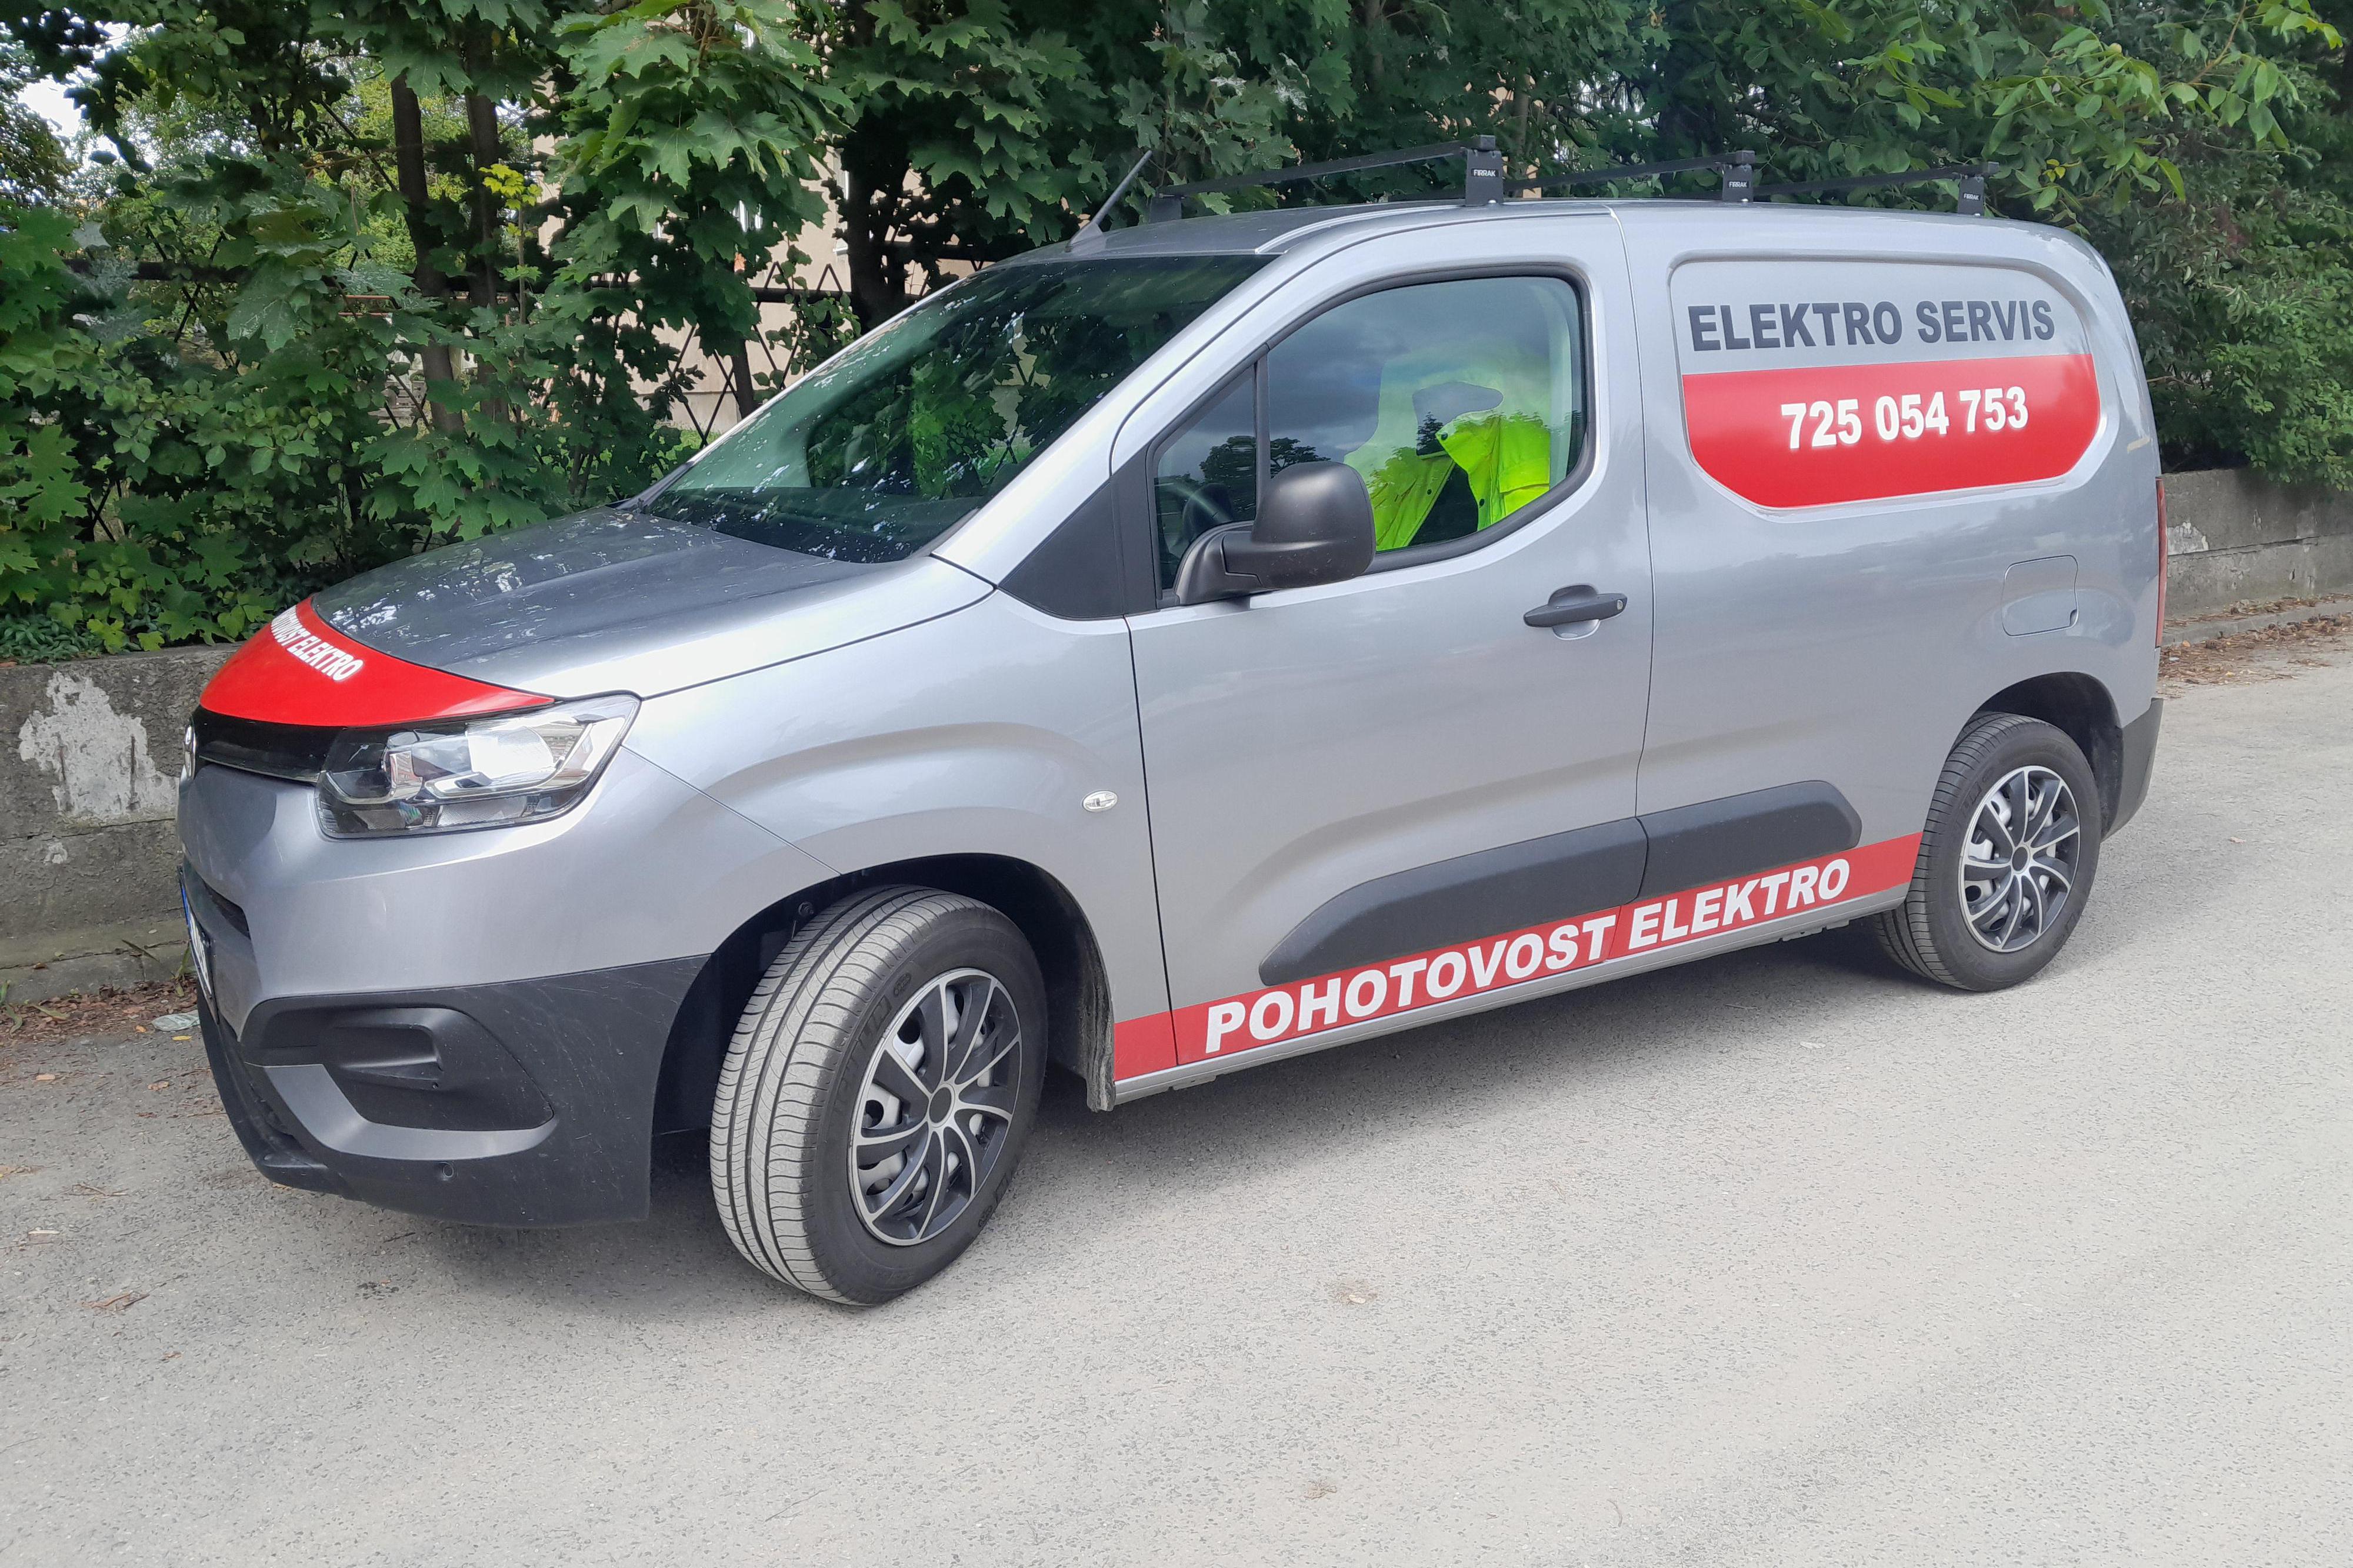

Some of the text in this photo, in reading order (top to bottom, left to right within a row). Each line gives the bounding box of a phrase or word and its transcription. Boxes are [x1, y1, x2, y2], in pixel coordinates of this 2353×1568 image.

[1473, 169, 1496, 177] FIRRAK
[1688, 300, 2055, 352] ELEKTRO SERVIS
[1781, 386, 2029, 449] 725 054 753
[286, 635, 364, 680] ELEKTRO
[1205, 858, 1851, 1055] POHOTOVOST ELEKTRO
